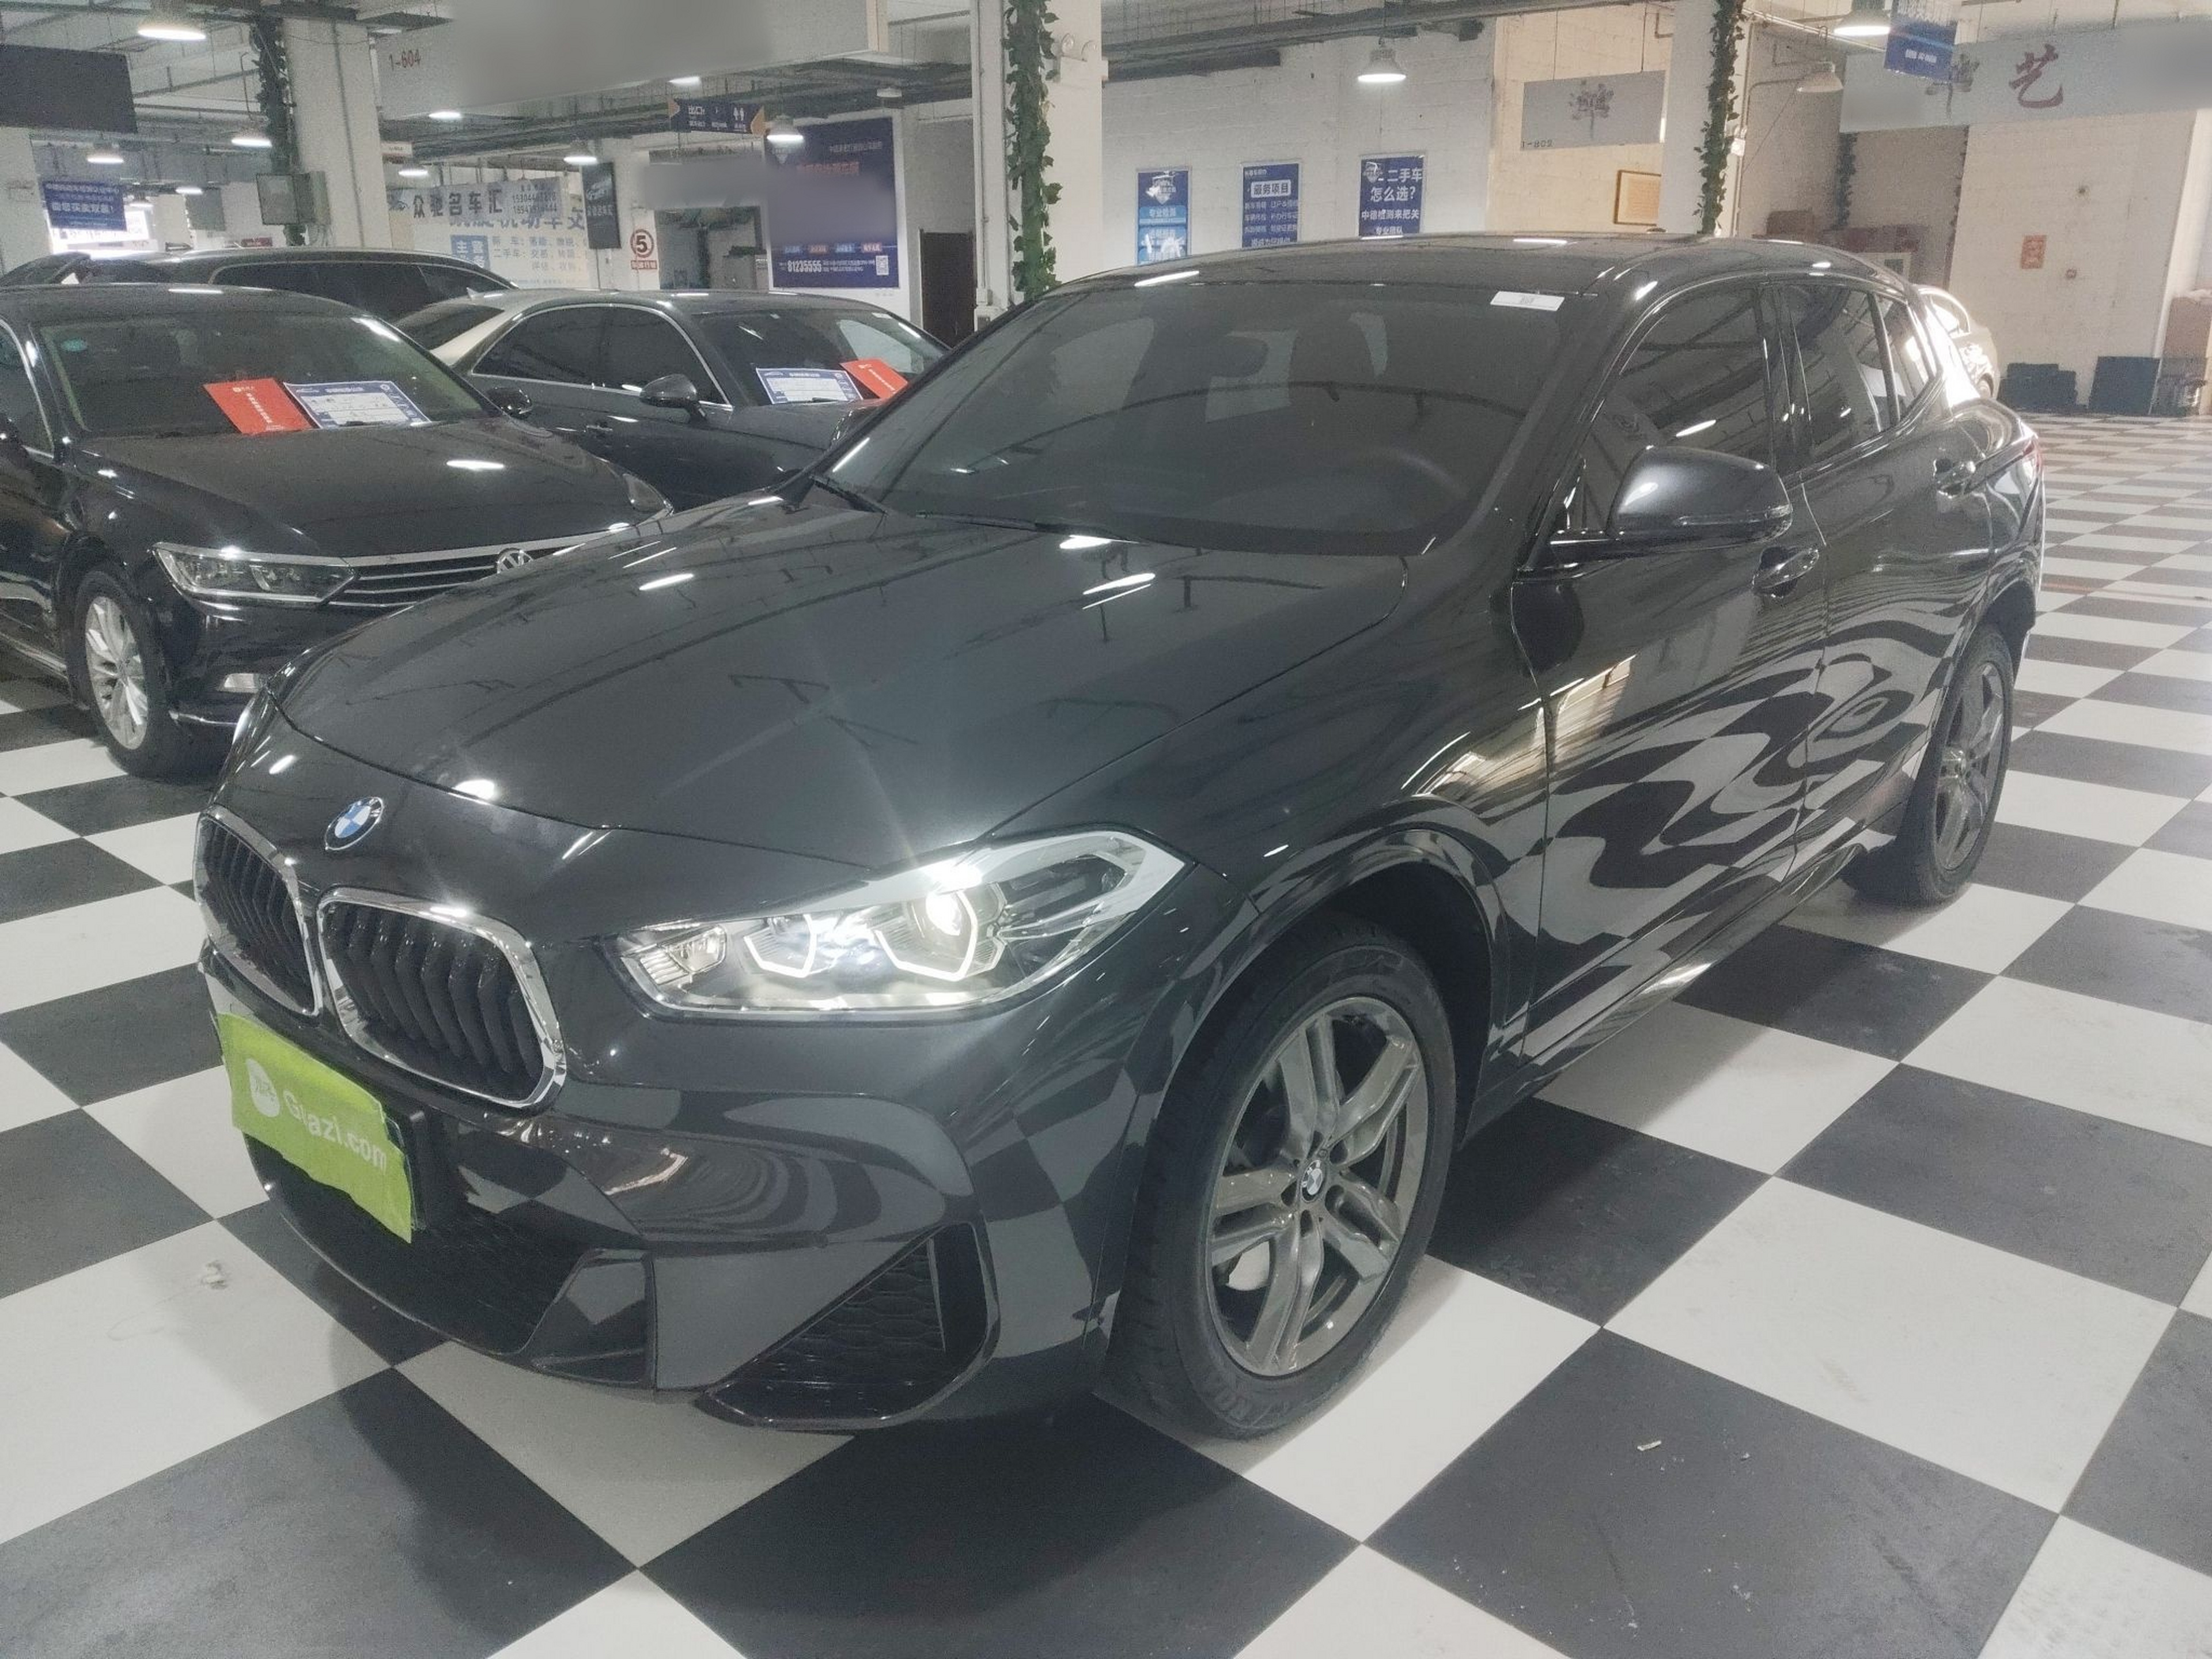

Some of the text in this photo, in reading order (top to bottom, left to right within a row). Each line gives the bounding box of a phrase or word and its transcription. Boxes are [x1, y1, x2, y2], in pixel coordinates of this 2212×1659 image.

[388, 50, 422, 70] 1-604
[2009, 44, 2064, 108] 艺
[1387, 167, 1423, 183] 二手车
[636, 235, 647, 253] 5
